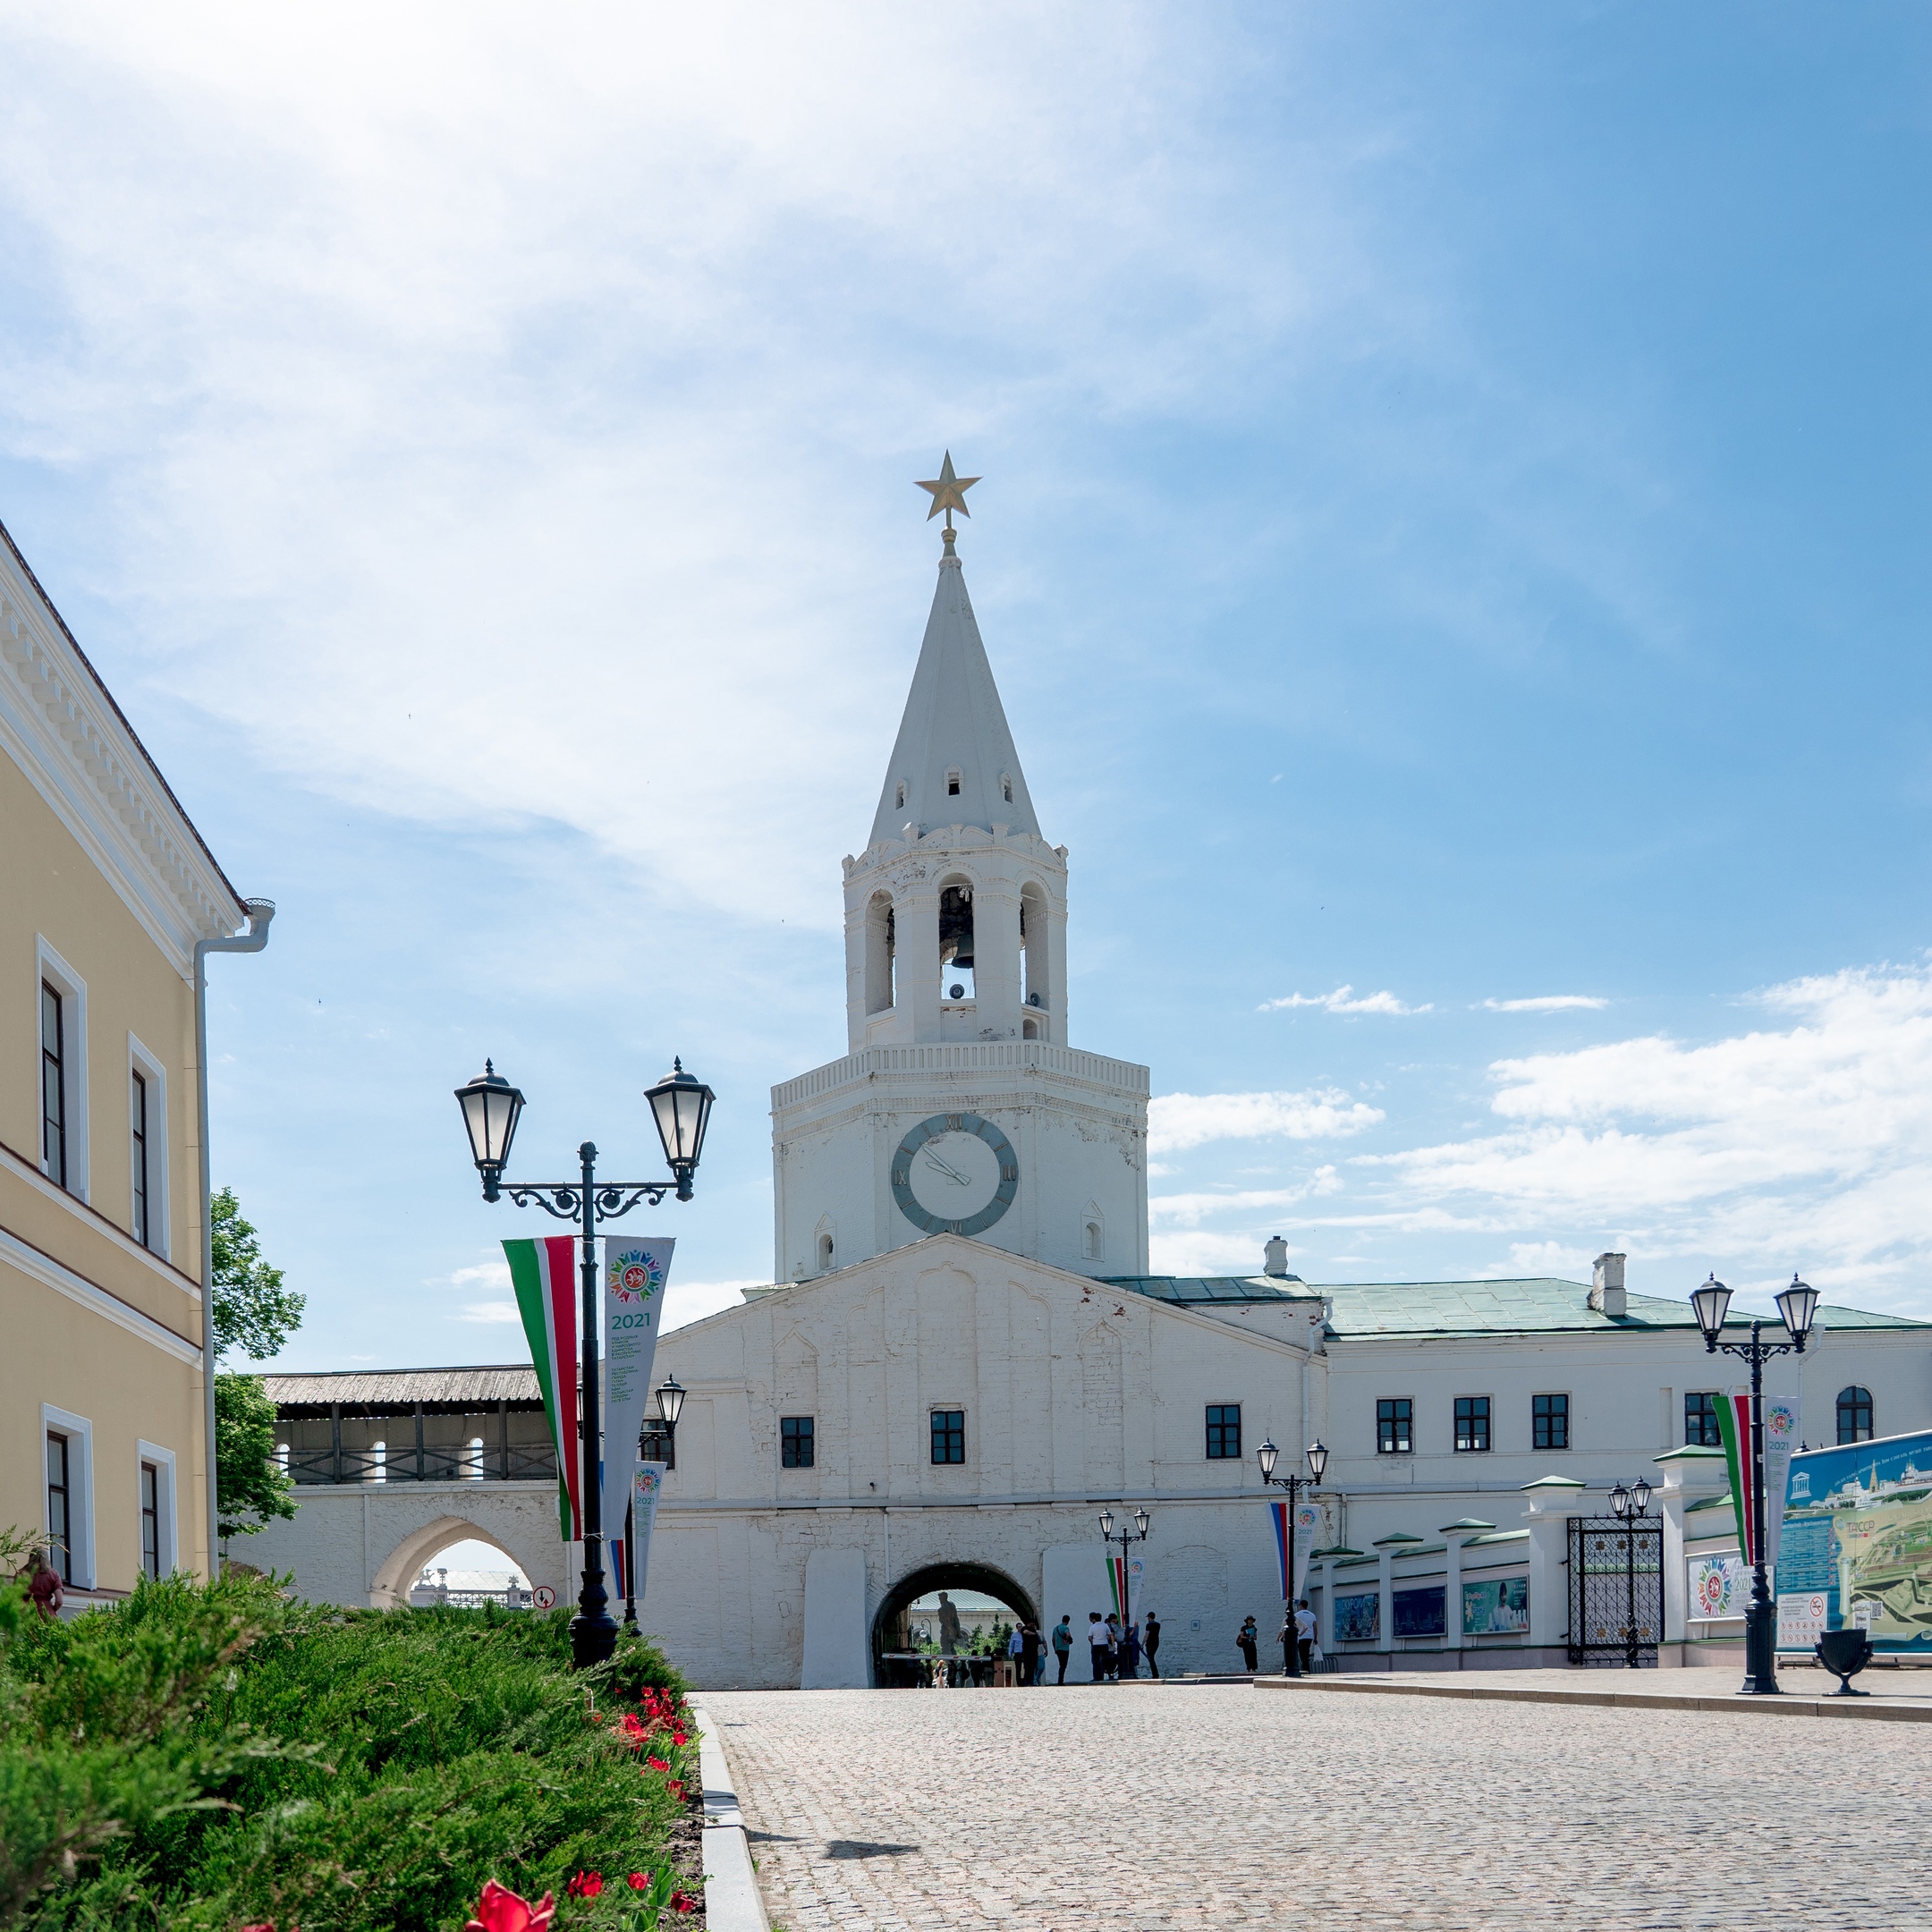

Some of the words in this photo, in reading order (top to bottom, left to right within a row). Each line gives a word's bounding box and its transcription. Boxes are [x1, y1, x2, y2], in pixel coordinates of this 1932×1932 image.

[945, 1114, 962, 1130] XII
[894, 1169, 908, 1185] IX
[1003, 1165, 1016, 1181] III
[950, 1220, 962, 1235] VI
[612, 1312, 650, 1330] 2021
[1769, 1441, 1789, 1450] 2021
[637, 1496, 655, 1504] 2021
[1734, 1576, 1752, 1590] 2021
